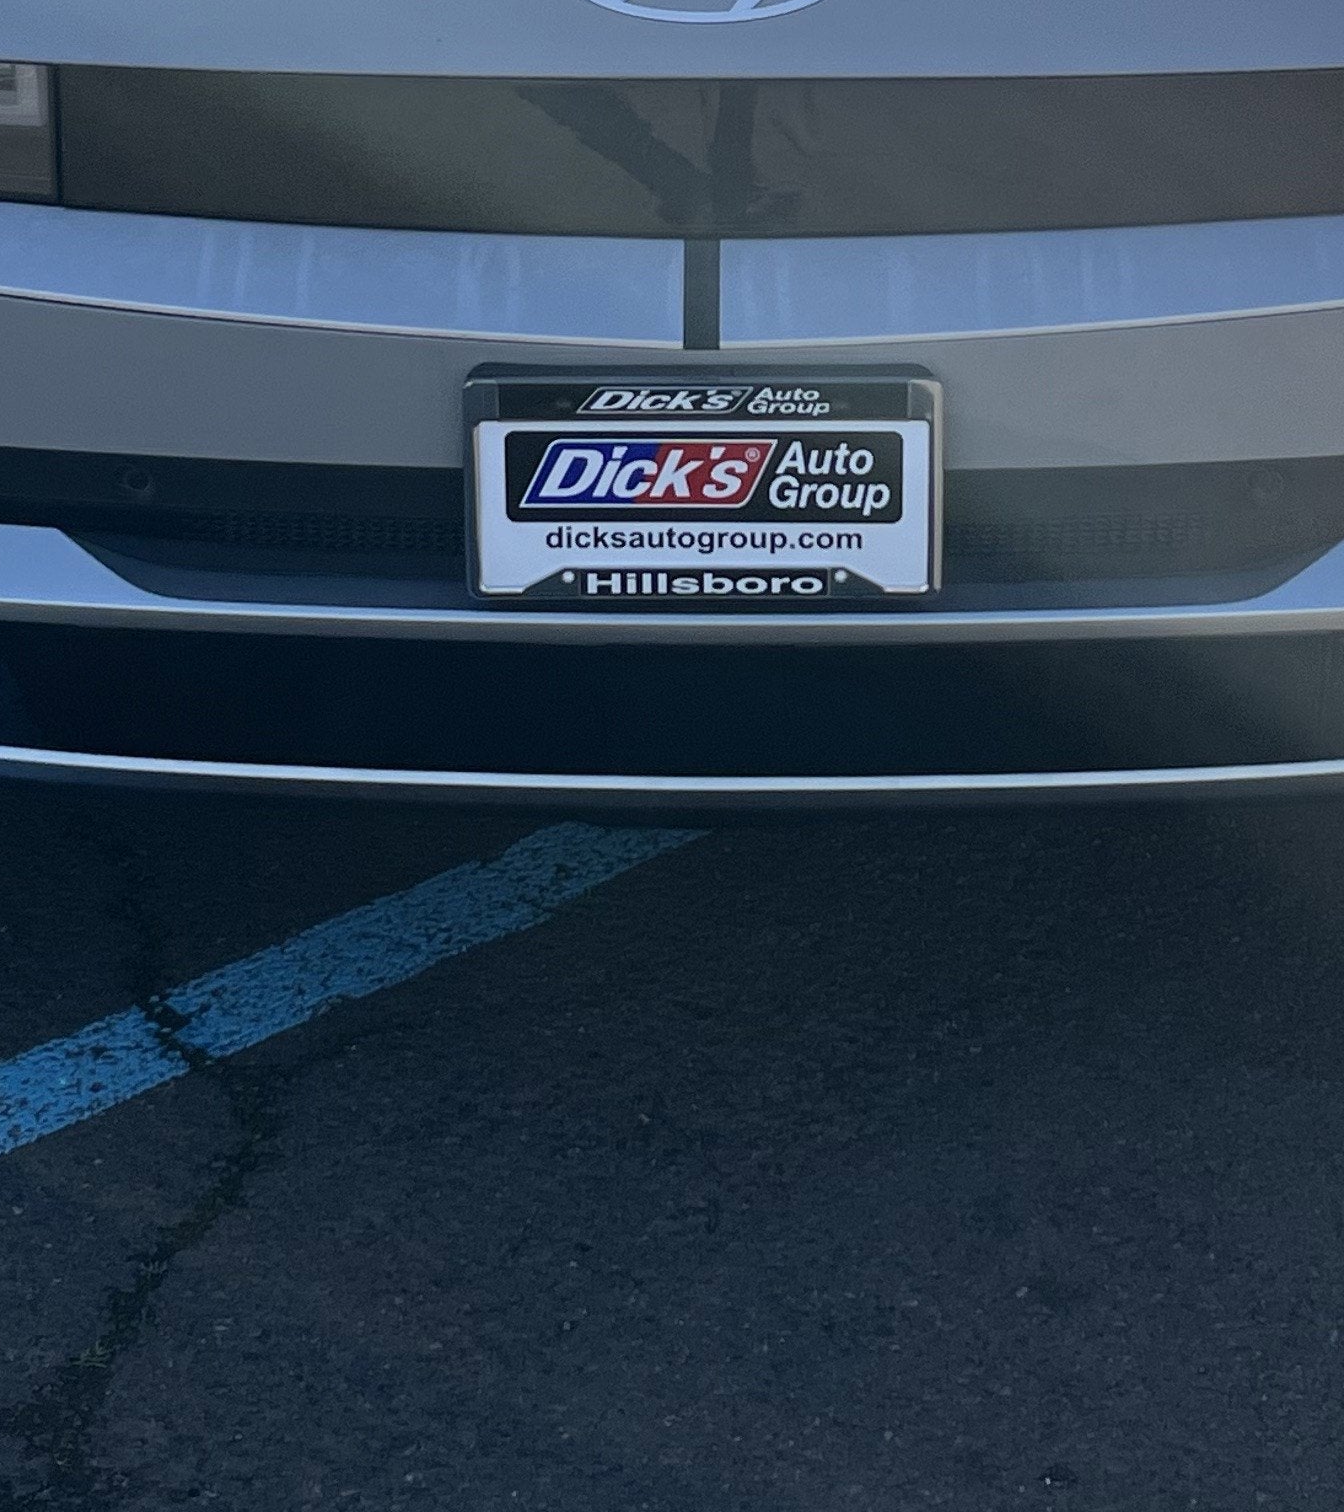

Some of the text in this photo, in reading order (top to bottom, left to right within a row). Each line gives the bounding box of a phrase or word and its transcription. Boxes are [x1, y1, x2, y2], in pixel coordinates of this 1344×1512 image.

[590, 387, 821, 410] Dick's Auto
[746, 399, 831, 417] Group
[538, 441, 874, 500] Dick's Auto
[768, 475, 891, 517] Group
[545, 526, 864, 555] dicksautogroup.com
[586, 571, 824, 595] Hillsboro
